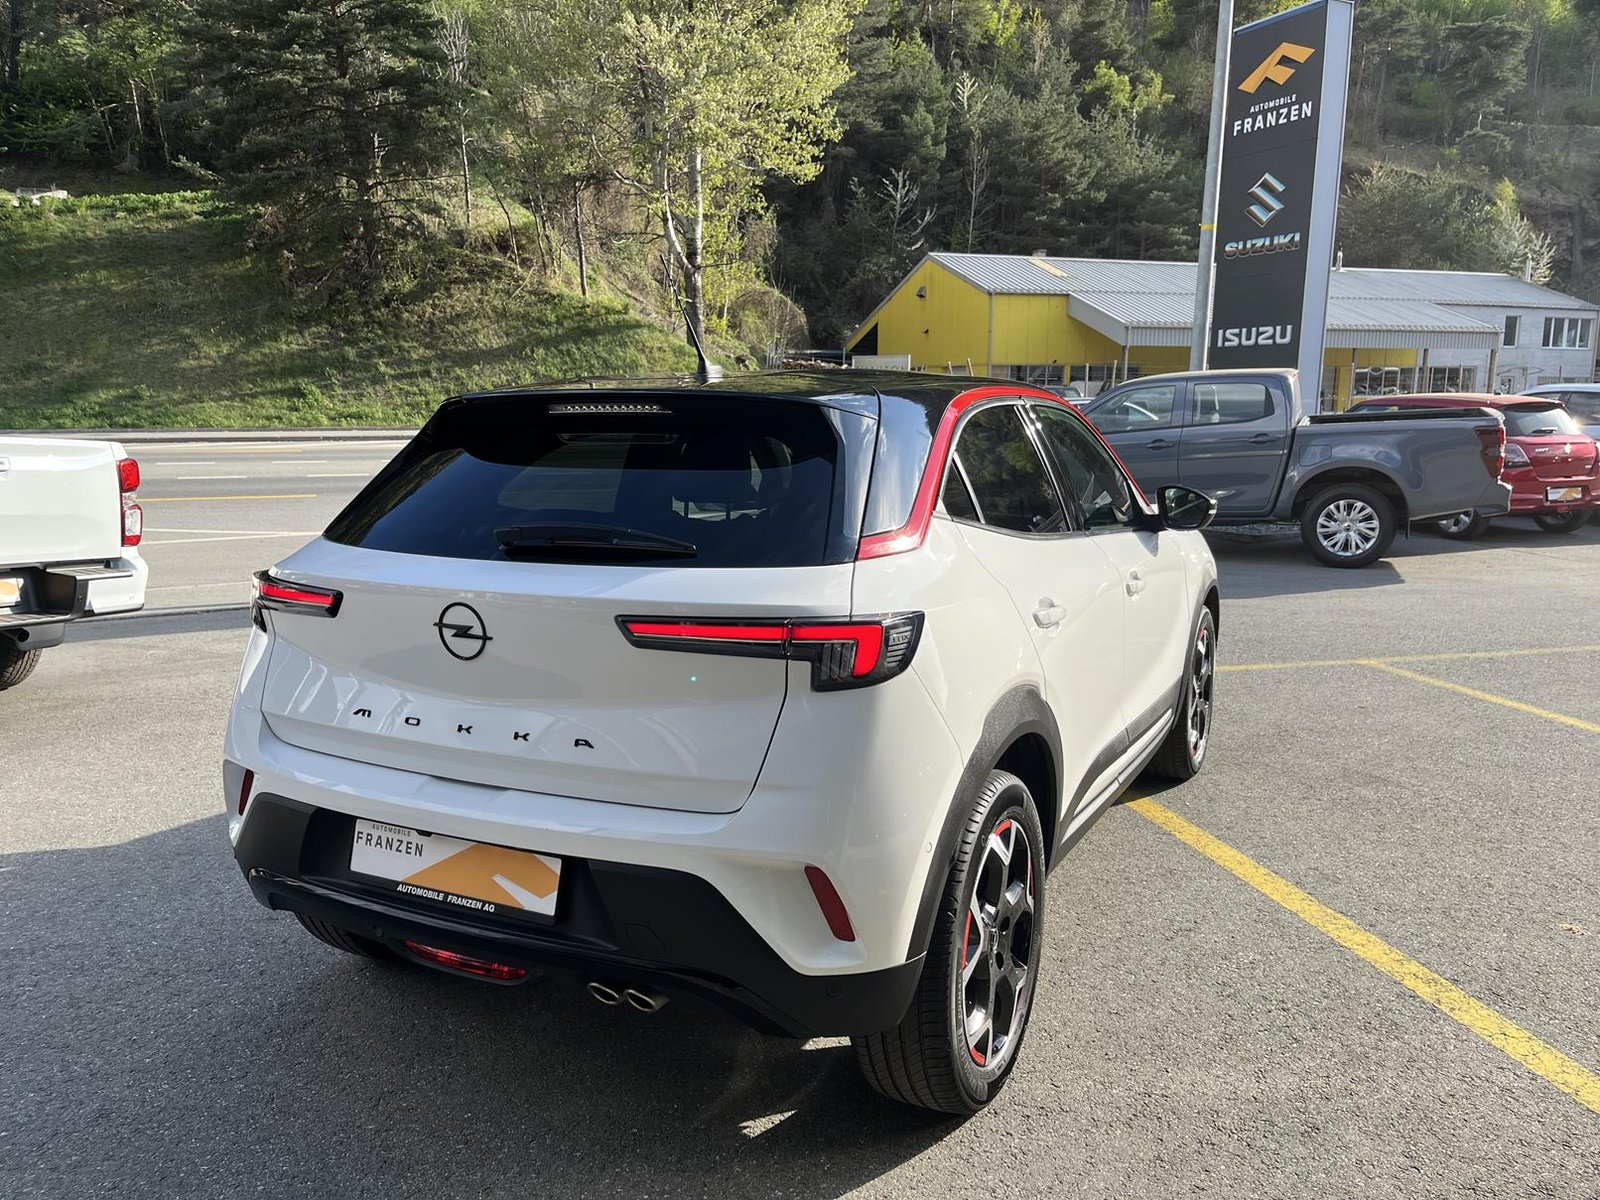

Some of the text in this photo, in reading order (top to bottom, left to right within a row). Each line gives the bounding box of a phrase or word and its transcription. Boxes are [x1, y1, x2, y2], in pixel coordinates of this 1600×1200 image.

[1250, 94, 1297, 113] AUTOMOBILE
[1233, 101, 1312, 136] FRANZEN
[1224, 232, 1300, 259] SUZUKI
[1217, 325, 1292, 347] ISUZU
[353, 708, 594, 749] MOKKA
[372, 823, 411, 837] AUTOMOBILE
[356, 831, 424, 857] FRANZEN
[396, 883, 495, 912] AUTOMOBILE FRANZEN AG
